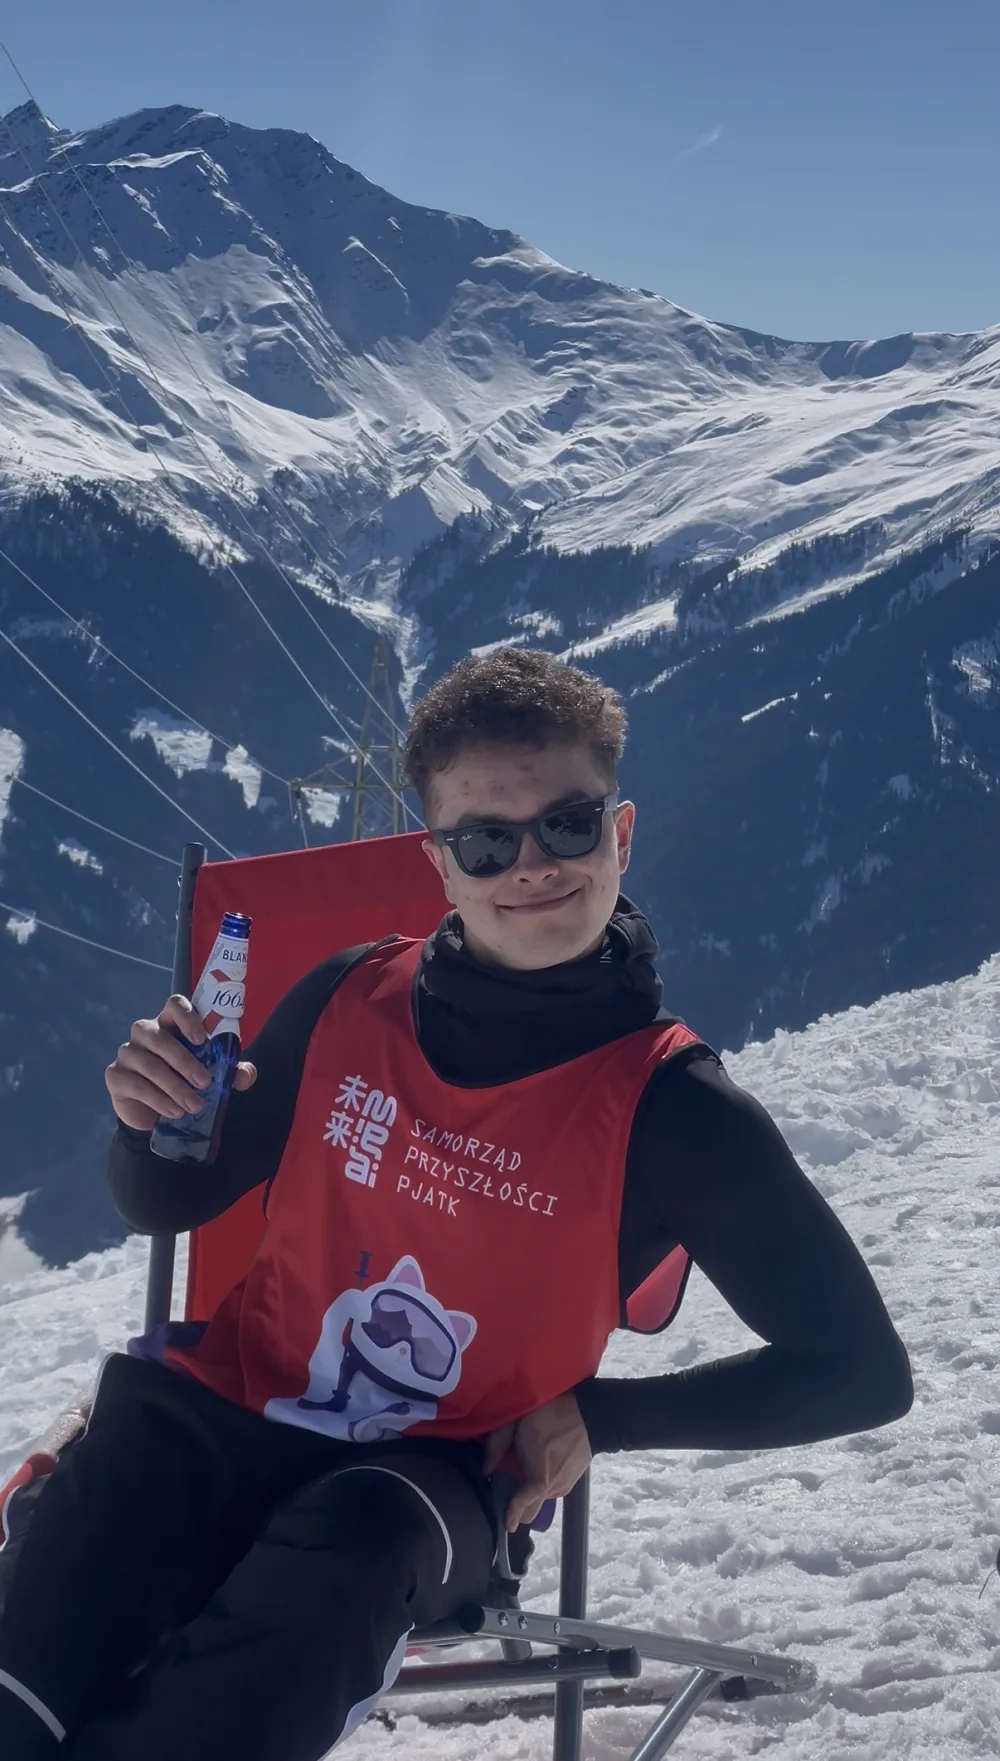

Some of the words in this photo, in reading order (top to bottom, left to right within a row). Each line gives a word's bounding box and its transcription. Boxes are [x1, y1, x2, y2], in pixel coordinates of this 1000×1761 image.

[323, 1074, 369, 1149] 未来
[411, 1118, 521, 1172] SAMORZĄD
[396, 1174, 460, 1217] PJATK
[404, 1145, 558, 1216] PRZYSZŁOŚCI
